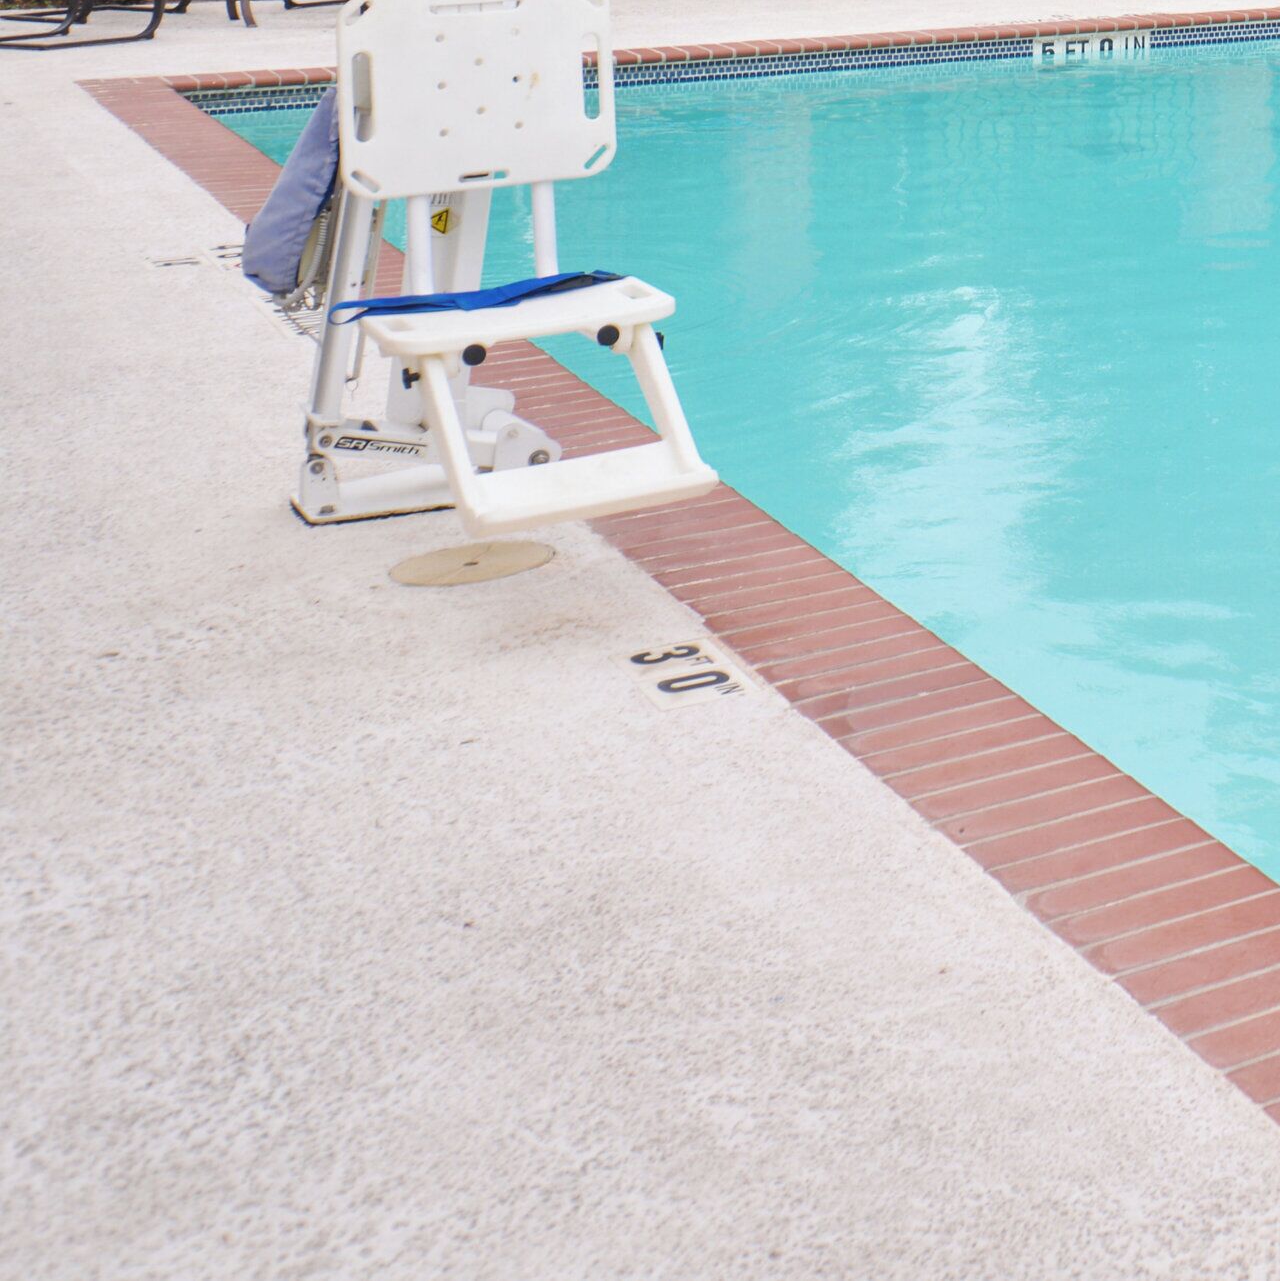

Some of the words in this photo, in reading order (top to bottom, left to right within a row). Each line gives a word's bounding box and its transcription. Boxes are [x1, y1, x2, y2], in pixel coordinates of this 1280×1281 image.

[1042, 42, 1055, 55] 5
[1066, 40, 1089, 55] FT
[1125, 36, 1145, 50] IN
[336, 438, 367, 450] SR
[368, 440, 420, 455] Smith
[630, 646, 700, 664] 3
[657, 671, 730, 693] 0
